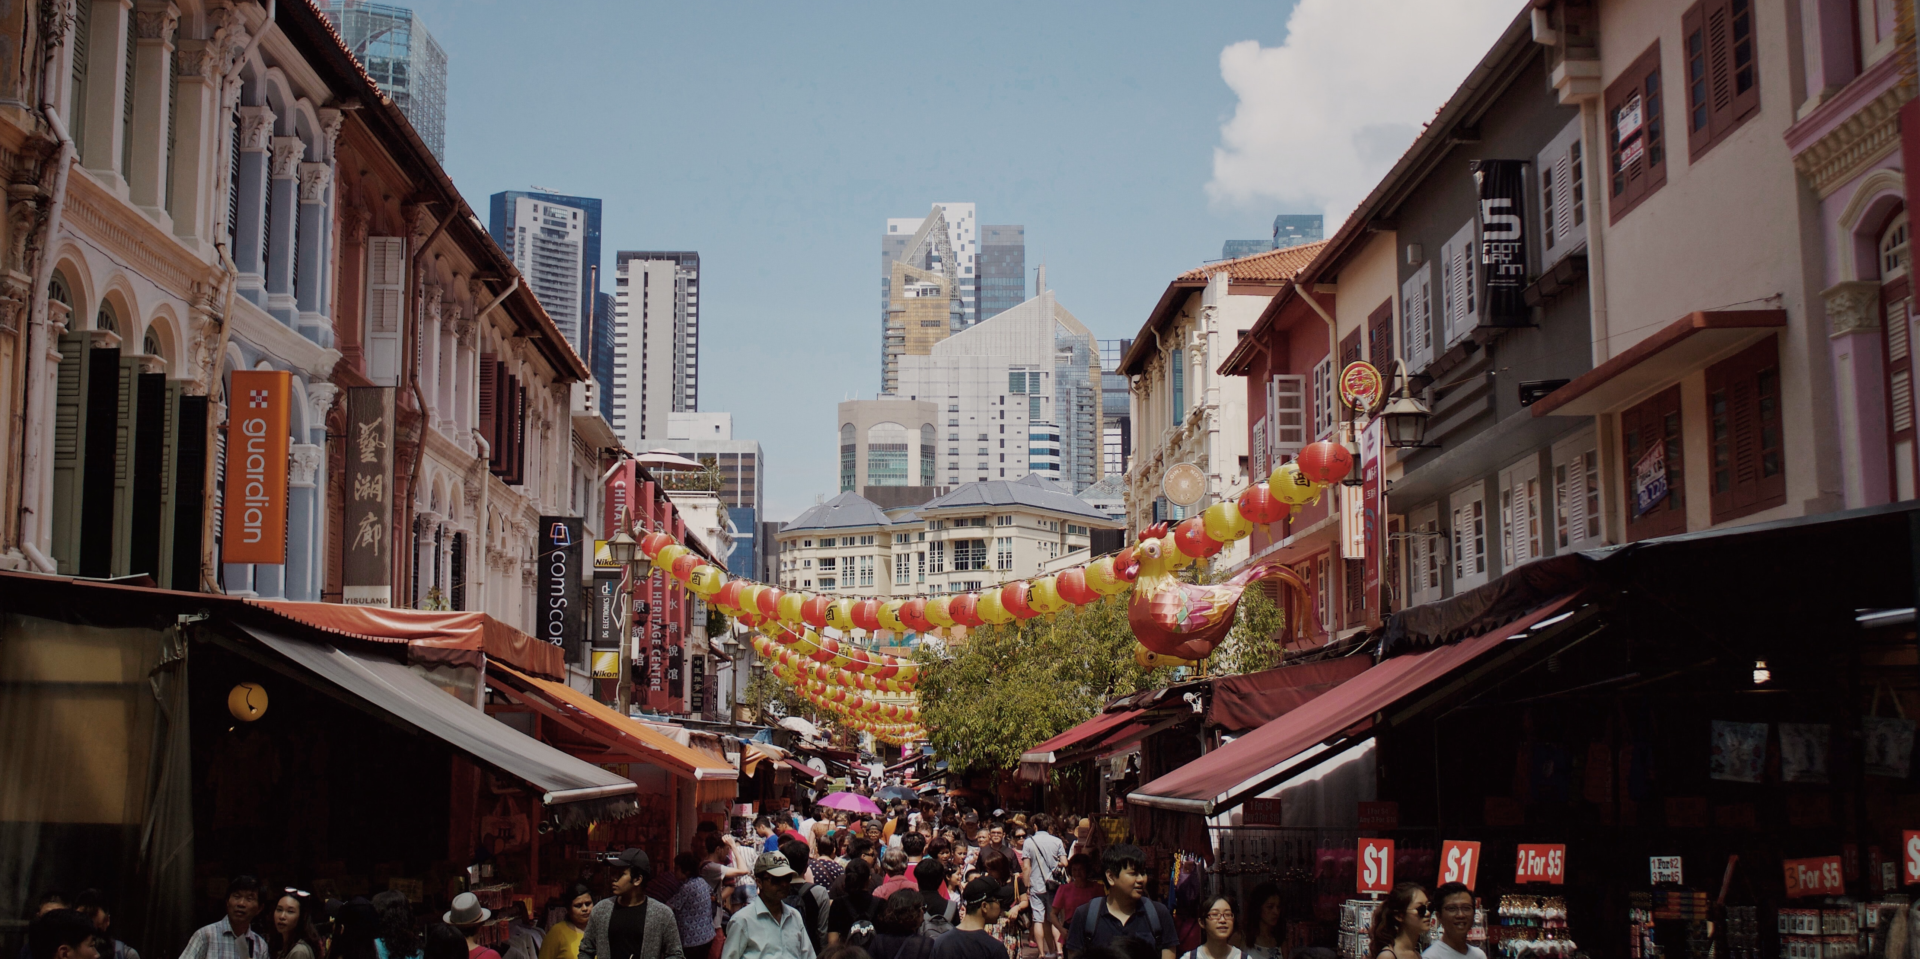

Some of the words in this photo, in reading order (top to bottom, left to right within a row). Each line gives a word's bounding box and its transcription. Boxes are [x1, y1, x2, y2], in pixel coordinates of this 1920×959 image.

[1482, 198, 1521, 240] 5
[1482, 242, 1522, 254] FOOT
[243, 418, 269, 543] guardian
[651, 592, 662, 645] HERITAGE
[592, 670, 617, 678] Nikon
[651, 649, 661, 691] CENTRE
[1363, 843, 1388, 888] $1
[1444, 845, 1472, 884] $1
[1517, 856, 1525, 875] 2
[1527, 856, 1545, 875] For
[1547, 849, 1562, 878] $5
[1657, 858, 1670, 869] For
[1670, 858, 1678, 868] $2
[1786, 867, 1797, 889] 3
[1798, 865, 1819, 889] For
[1822, 862, 1839, 890] $5
